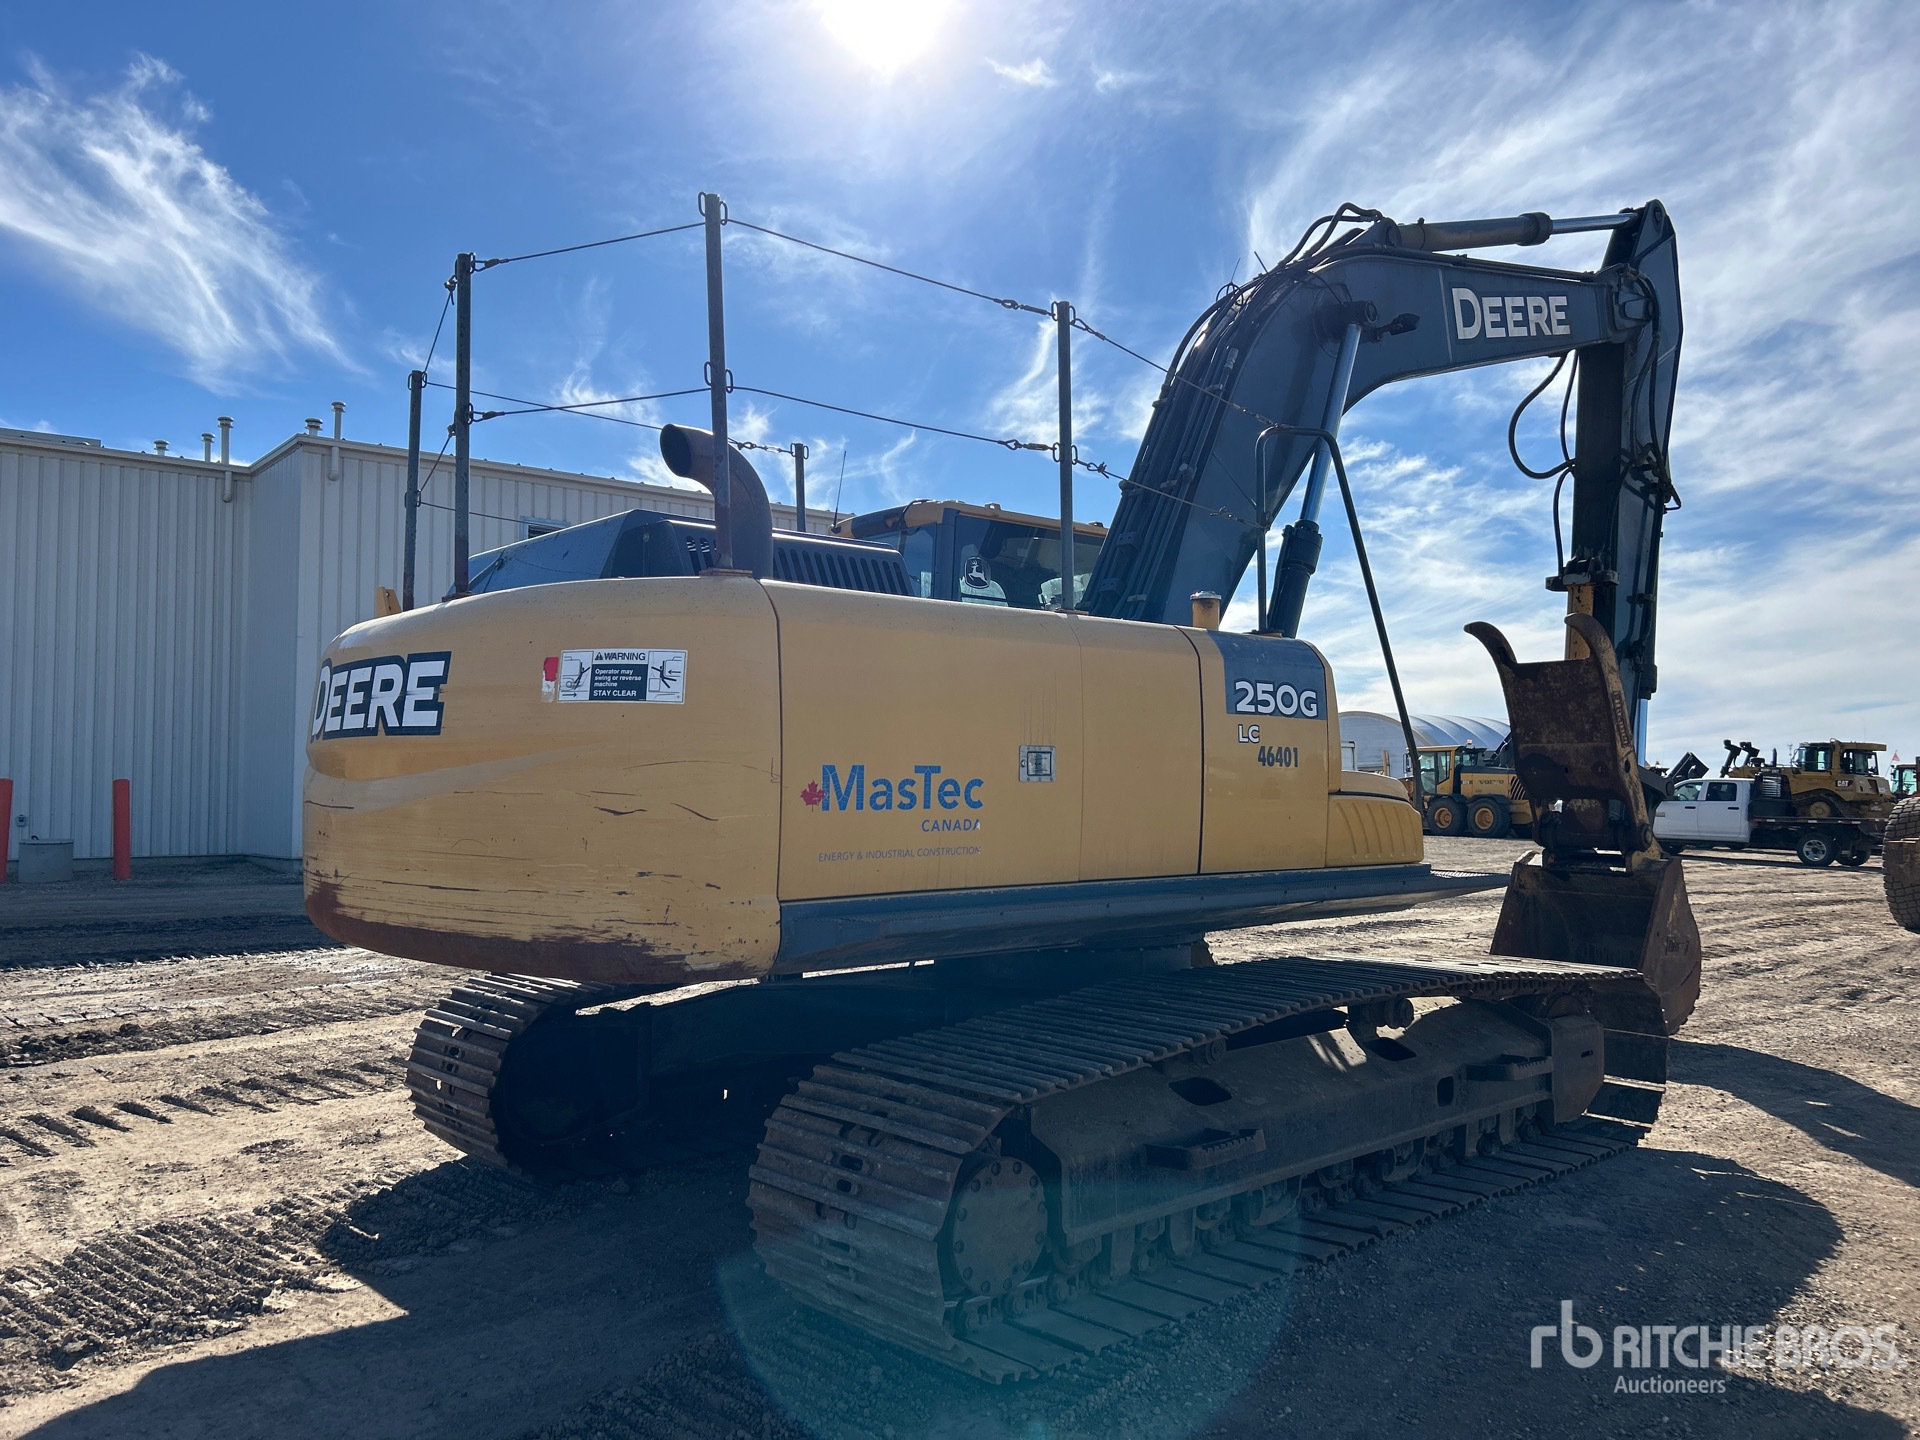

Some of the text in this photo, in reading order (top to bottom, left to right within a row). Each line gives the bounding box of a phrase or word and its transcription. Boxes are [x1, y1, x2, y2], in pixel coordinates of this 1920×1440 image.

[1452, 288, 1570, 339] DEERE
[604, 652, 645, 660] WARNING
[312, 661, 445, 736] DEERE
[1235, 681, 1318, 717] 250G
[1238, 725, 1260, 743] LC
[1258, 746, 1298, 767] 46401
[821, 764, 984, 811] MasTec
[921, 818, 981, 832] CANADA
[818, 846, 981, 862] ENERGY & INDUSTRIAL CONSTRUCTION
